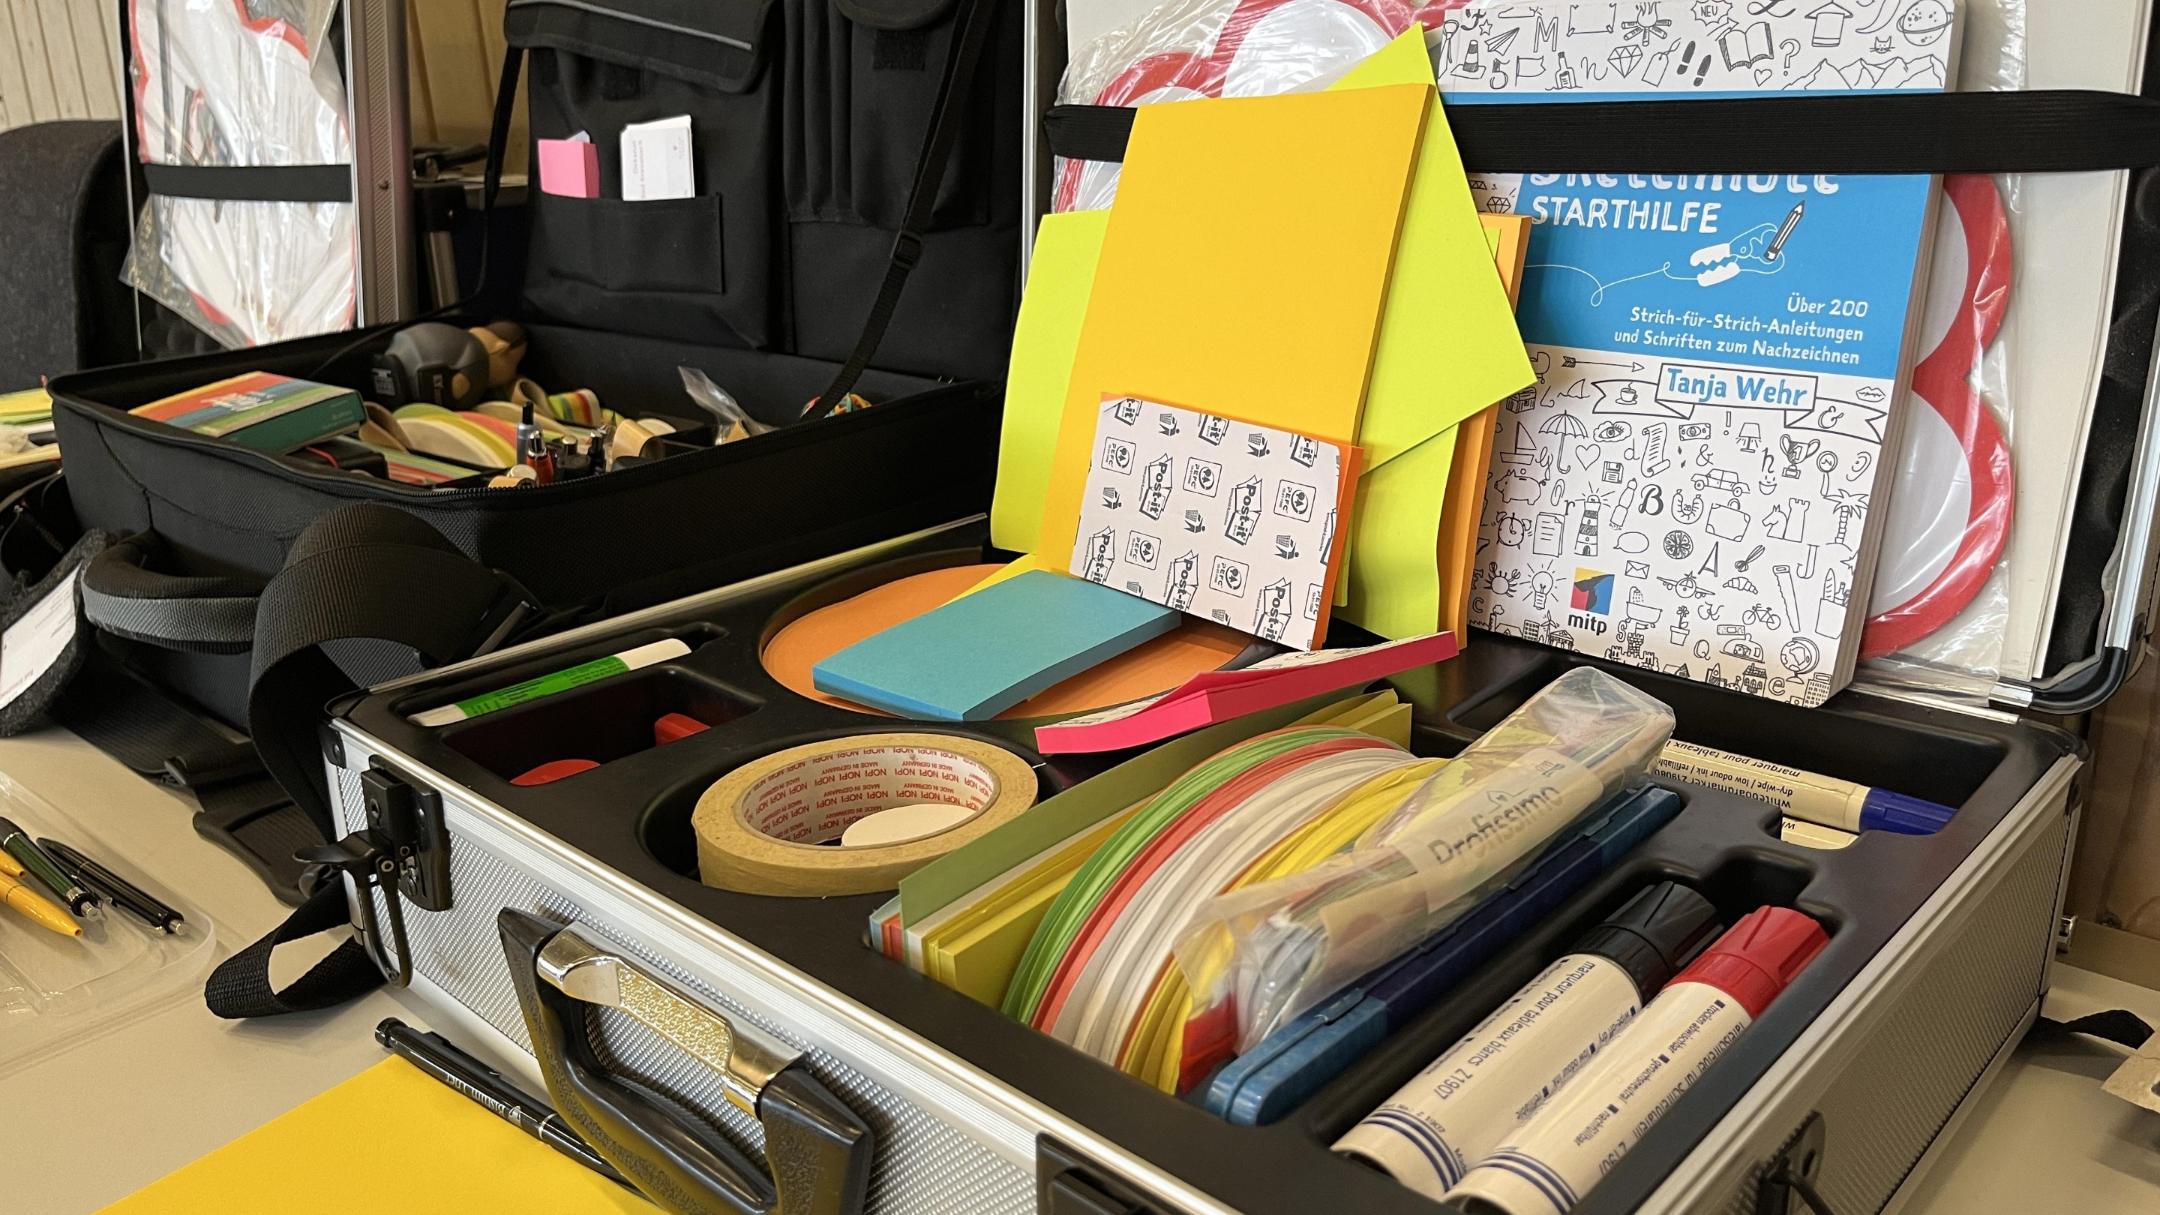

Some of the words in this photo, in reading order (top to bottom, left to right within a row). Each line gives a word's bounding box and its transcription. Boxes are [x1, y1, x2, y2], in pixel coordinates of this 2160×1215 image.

[1700, 5, 1719, 18] NEU
[1533, 17, 1558, 52] M
[1779, 38, 1800, 76] ?
[1531, 196, 1722, 233] STARTHILFE
[1788, 293, 1826, 316] Über
[1829, 298, 1869, 318] 200
[1629, 305, 1864, 345] Strich-für-Strich-Anleitungen
[1614, 329, 1640, 344] und
[1643, 330, 1712, 351] Schriften
[1716, 340, 1747, 354] zum
[1752, 339, 1860, 365] Nachzeichnen
[1667, 367, 1728, 403] Tanja
[1736, 375, 1808, 406] Wehr
[1696, 443, 1714, 467] &
[1149, 461, 1168, 515] Post-it
[1282, 486, 1293, 513] PEFC
[1638, 483, 1664, 516] B
[1236, 484, 1257, 538] Post-it
[1698, 540, 1720, 578] A
[1567, 613, 1608, 636] mitp
[1693, 639, 1711, 661] Q
[1768, 676, 1786, 697] e
[1674, 740, 1721, 759] tableaux
[1722, 753, 1752, 765] pour
[840, 771, 860, 780] NOPI
[865, 768, 886, 776] NOPI
[920, 769, 938, 778] NOPI
[1660, 759, 1690, 771] refillabl
[1696, 768, 1709, 777] ink
[1710, 770, 1733, 781] odour
[789, 782, 808, 794] NOPI
[814, 775, 835, 785] NOPI
[942, 773, 959, 783] NOPI
[1736, 776, 1750, 787] low
[1757, 781, 1794, 797] dry-wipe
[816, 797, 837, 808] NOPI
[841, 793, 862, 802] NOPI
[867, 790, 888, 799] NOPI
[896, 790, 917, 798] NOPI
[921, 792, 940, 800] NOPI
[1556, 961, 1596, 994] marqueur
[1536, 992, 1558, 1012] pour
[1500, 1009, 1541, 1041] tableaux
[1697, 1004, 1720, 1026] trocken
[1668, 1022, 1700, 1054] abwischbar
[1467, 1039, 1507, 1066] blancs
[1434, 1068, 1473, 1100] Z1907
[1618, 1058, 1662, 1104] geruchsneutral
[1574, 1110, 1610, 1147] nachfüllbar
